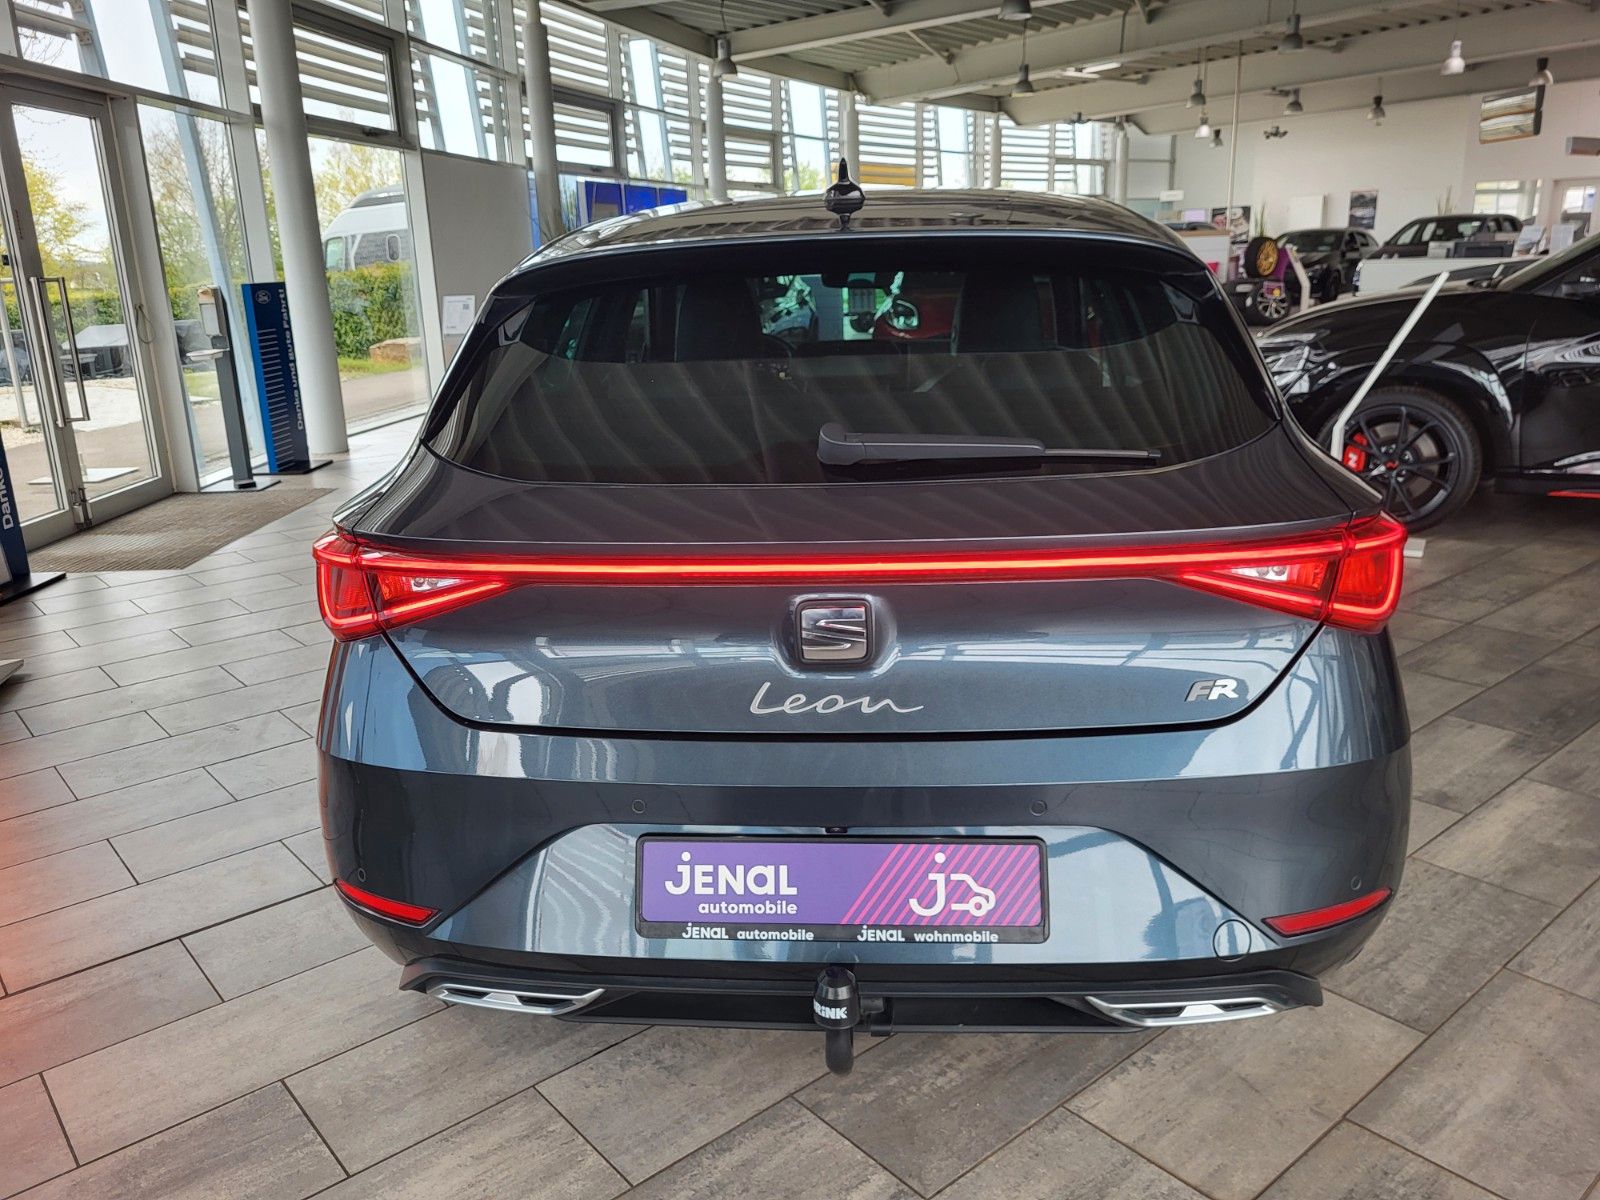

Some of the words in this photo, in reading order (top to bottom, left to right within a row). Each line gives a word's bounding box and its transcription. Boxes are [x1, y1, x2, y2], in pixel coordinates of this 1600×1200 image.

[288, 362, 299, 388] und
[293, 389, 304, 431] Danke
[750, 681, 924, 714] Leon
[1184, 678, 1239, 702] FR
[698, 900, 798, 915] automobile
[736, 928, 815, 941] automobile
[913, 930, 999, 943] wohnmobile
